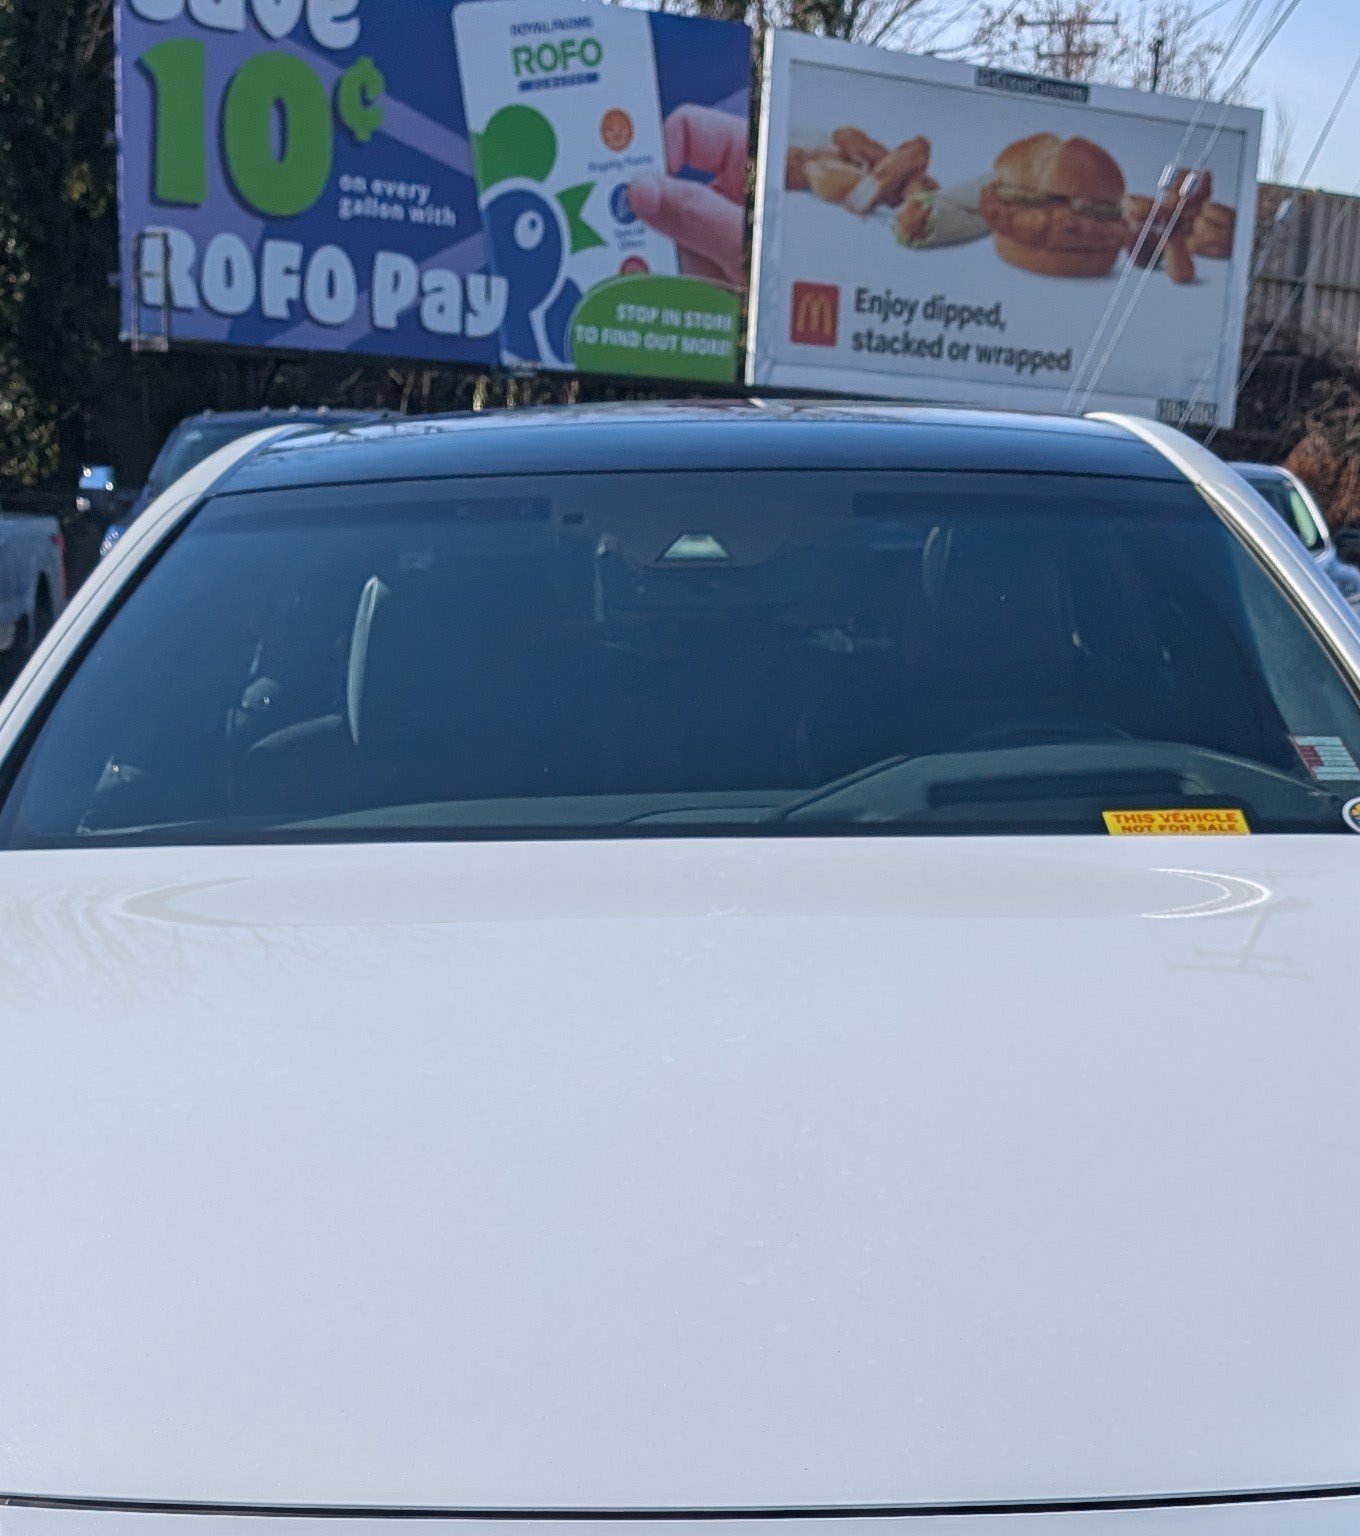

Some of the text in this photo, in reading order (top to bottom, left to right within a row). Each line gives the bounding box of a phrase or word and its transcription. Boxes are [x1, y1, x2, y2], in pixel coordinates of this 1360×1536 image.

[511, 36, 603, 77] ROFO
[339, 175, 432, 206] on every
[339, 196, 456, 227] gallon with
[141, 226, 509, 338] ROFO Pay
[616, 303, 659, 323] STOP
[661, 308, 681, 327] IN
[853, 286, 1007, 332] Enjoy dipped,
[576, 324, 599, 345] TO
[643, 332, 677, 351] OUT
[852, 328, 1073, 376] stacked or wrapped
[1111, 812, 1239, 824] THIS VEHICLE
[1121, 823, 1237, 833] NOT FOR SALE
